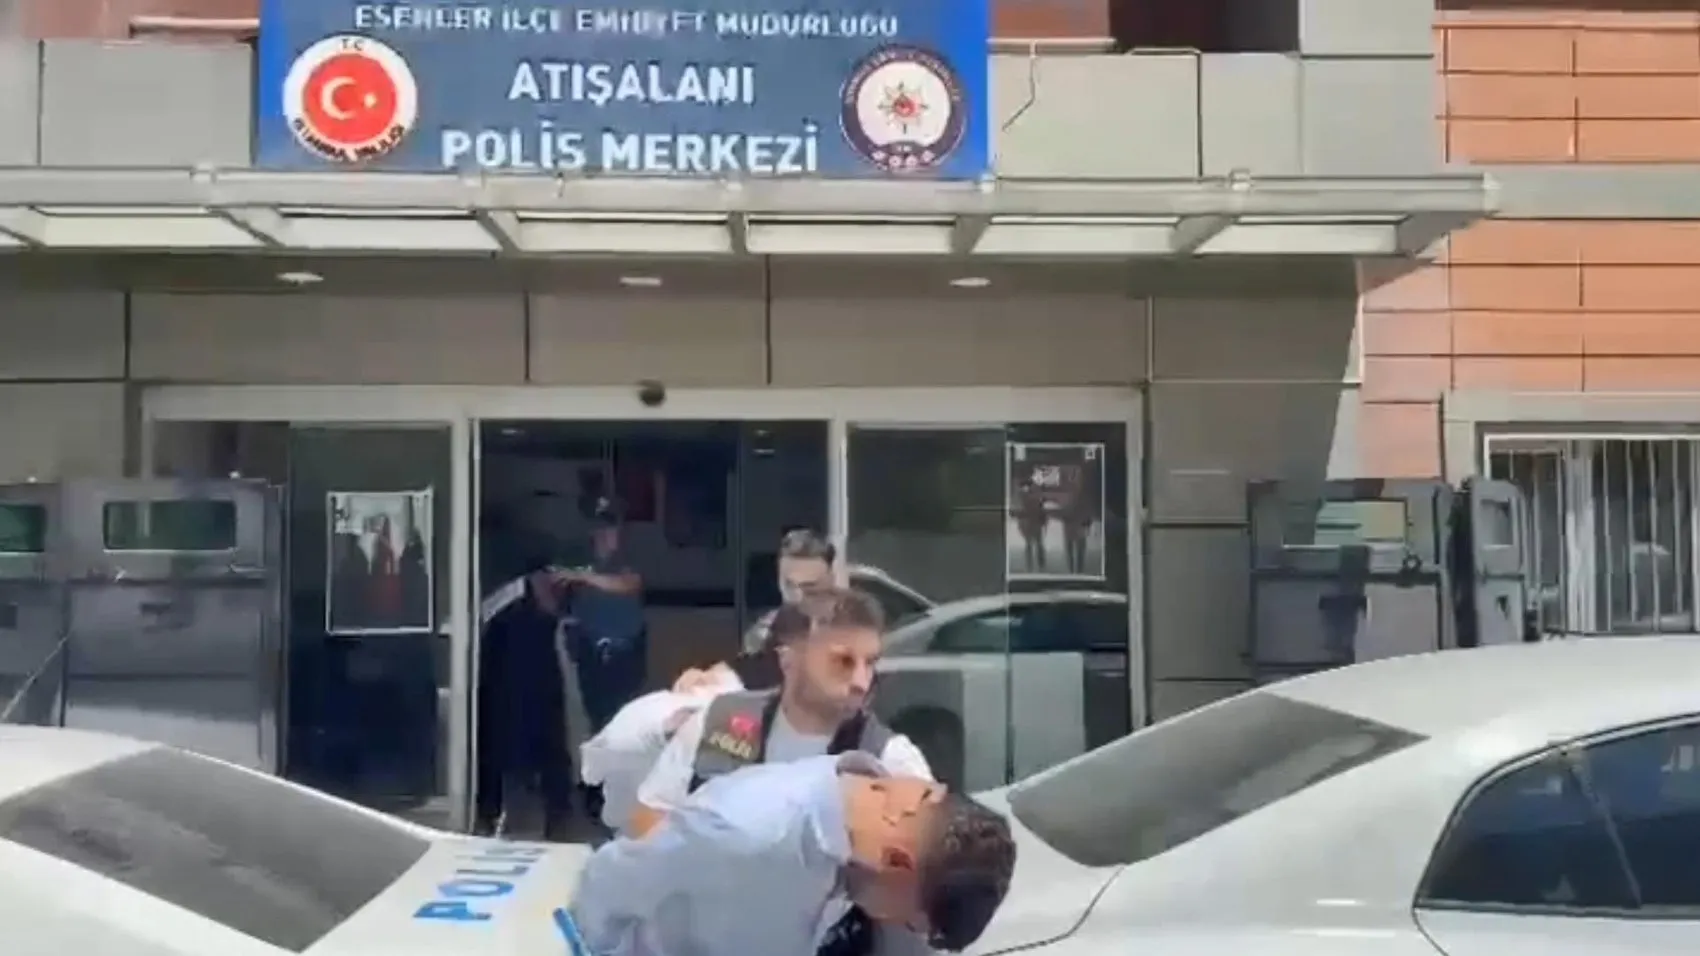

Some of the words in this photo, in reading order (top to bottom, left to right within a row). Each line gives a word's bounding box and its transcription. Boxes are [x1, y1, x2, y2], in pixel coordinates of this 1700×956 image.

[509, 62, 754, 105] ATIŞALANI
[442, 120, 586, 171] POLİS
[602, 124, 817, 172] MERKEZİ
